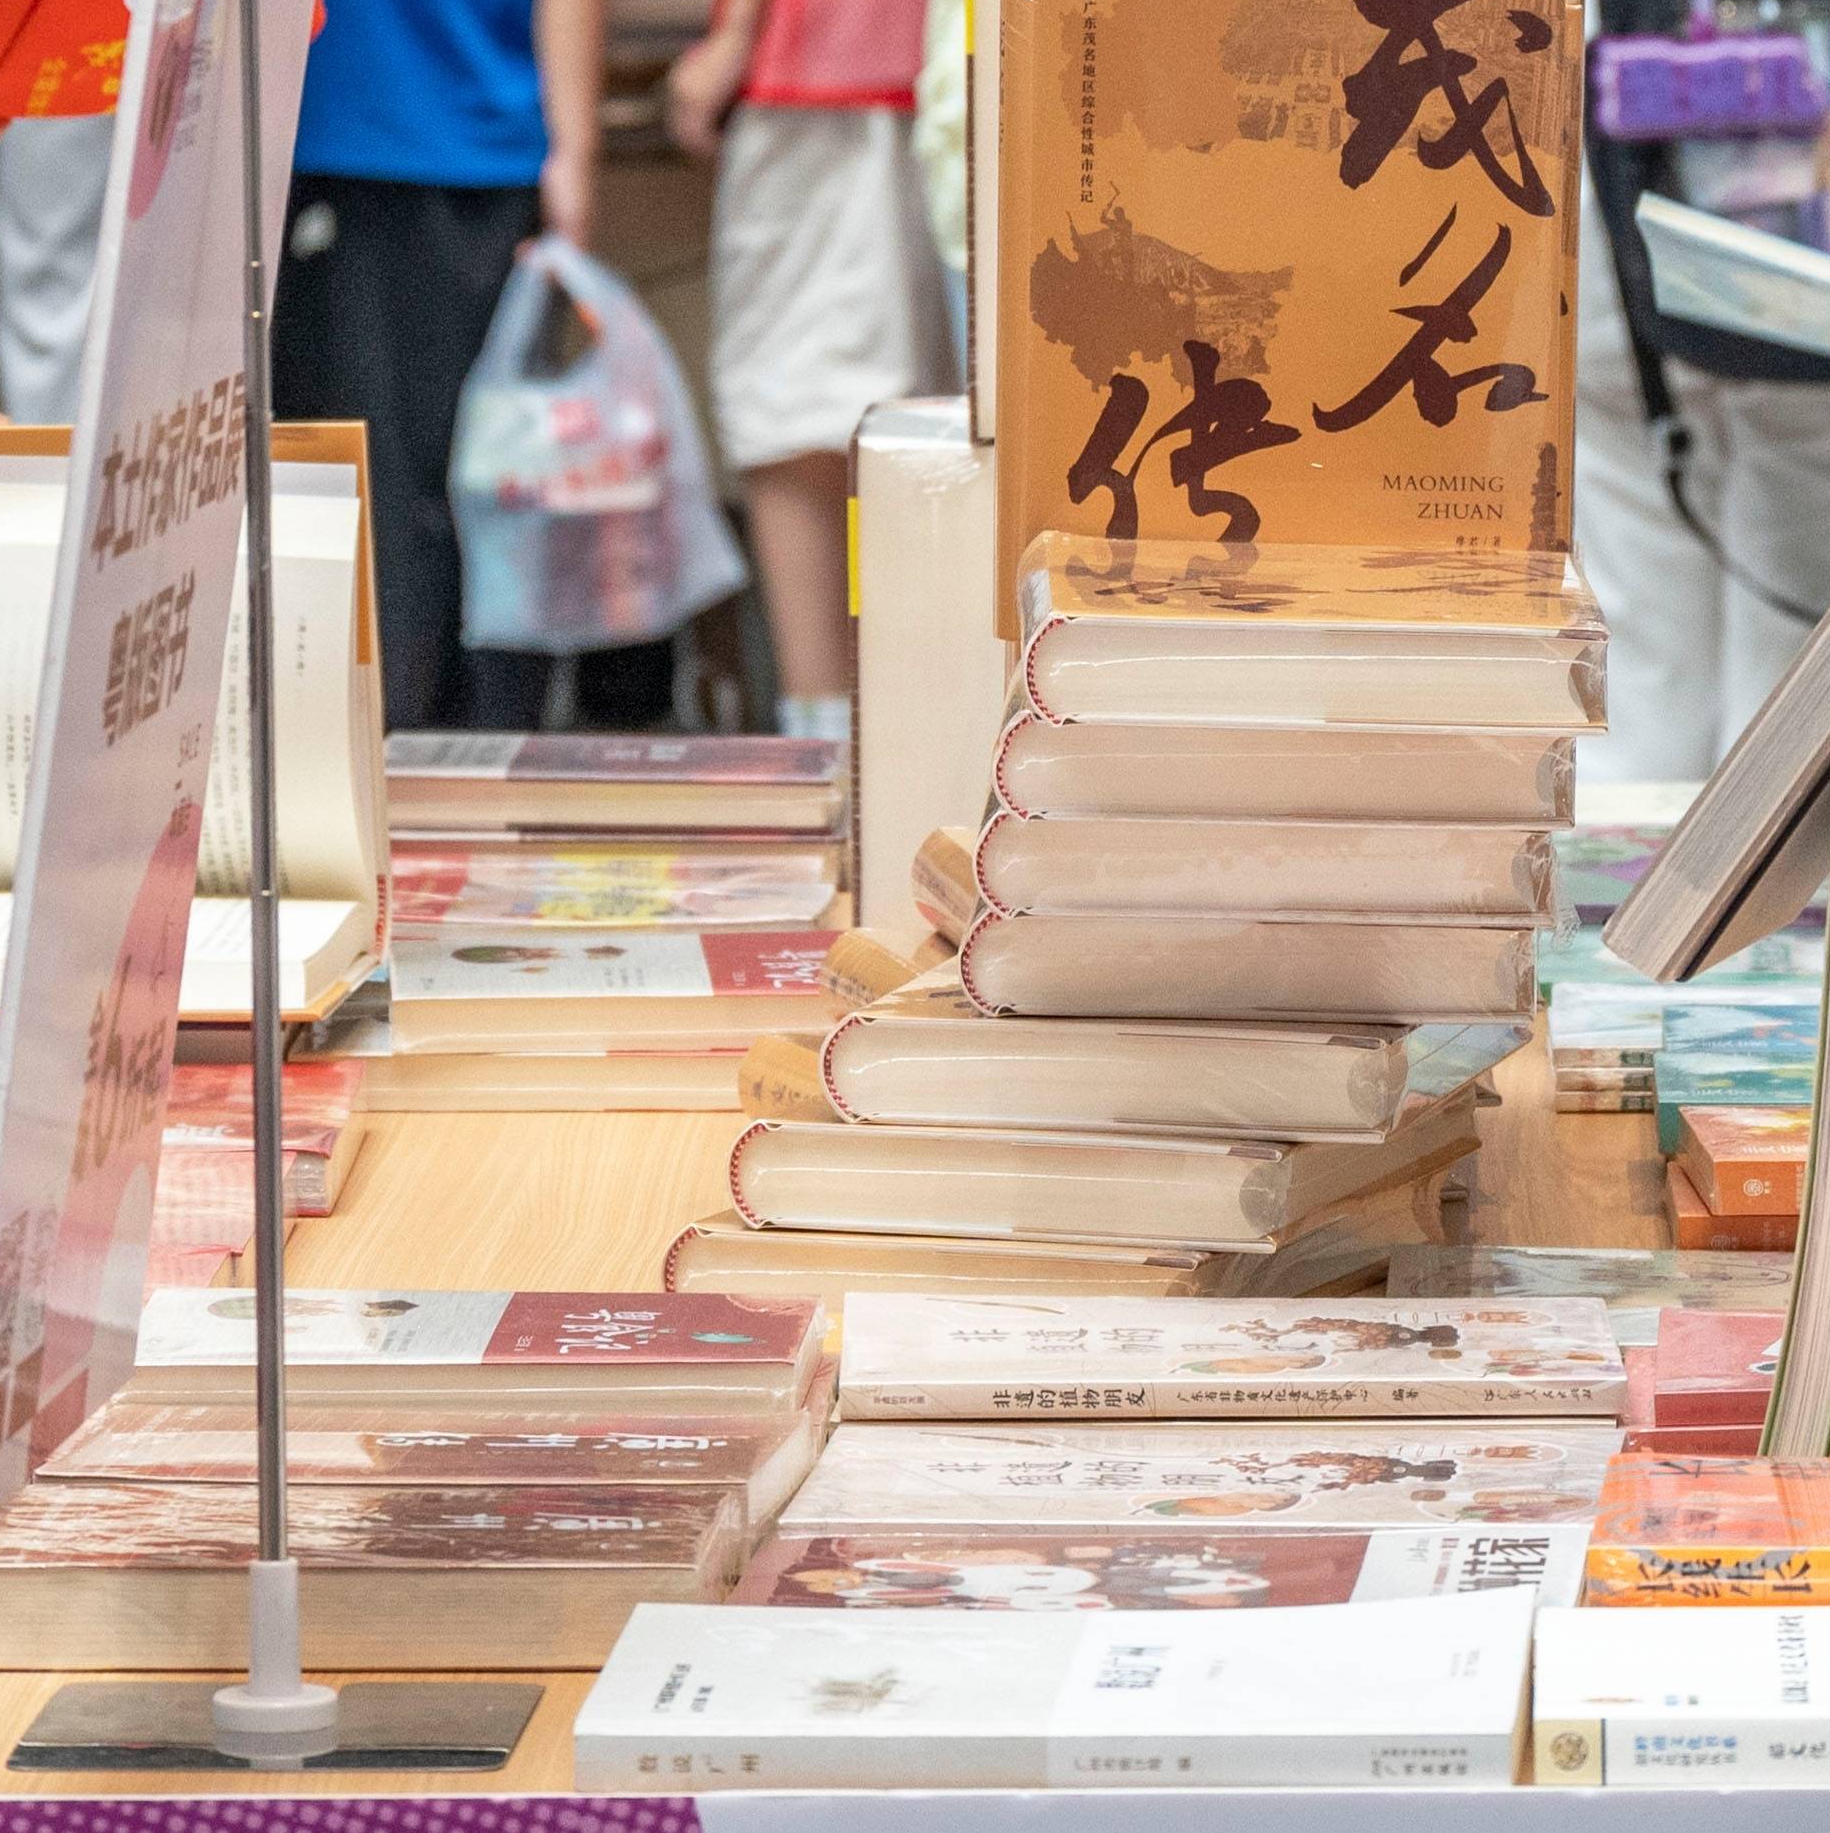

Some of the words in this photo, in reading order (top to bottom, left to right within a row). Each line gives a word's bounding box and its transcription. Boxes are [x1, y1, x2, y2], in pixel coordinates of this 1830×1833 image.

[1382, 474, 1505, 494] MAOMING
[1416, 502, 1504, 520] ZHUAN
[991, 1386, 1147, 1410] 非遗的植物朋友
